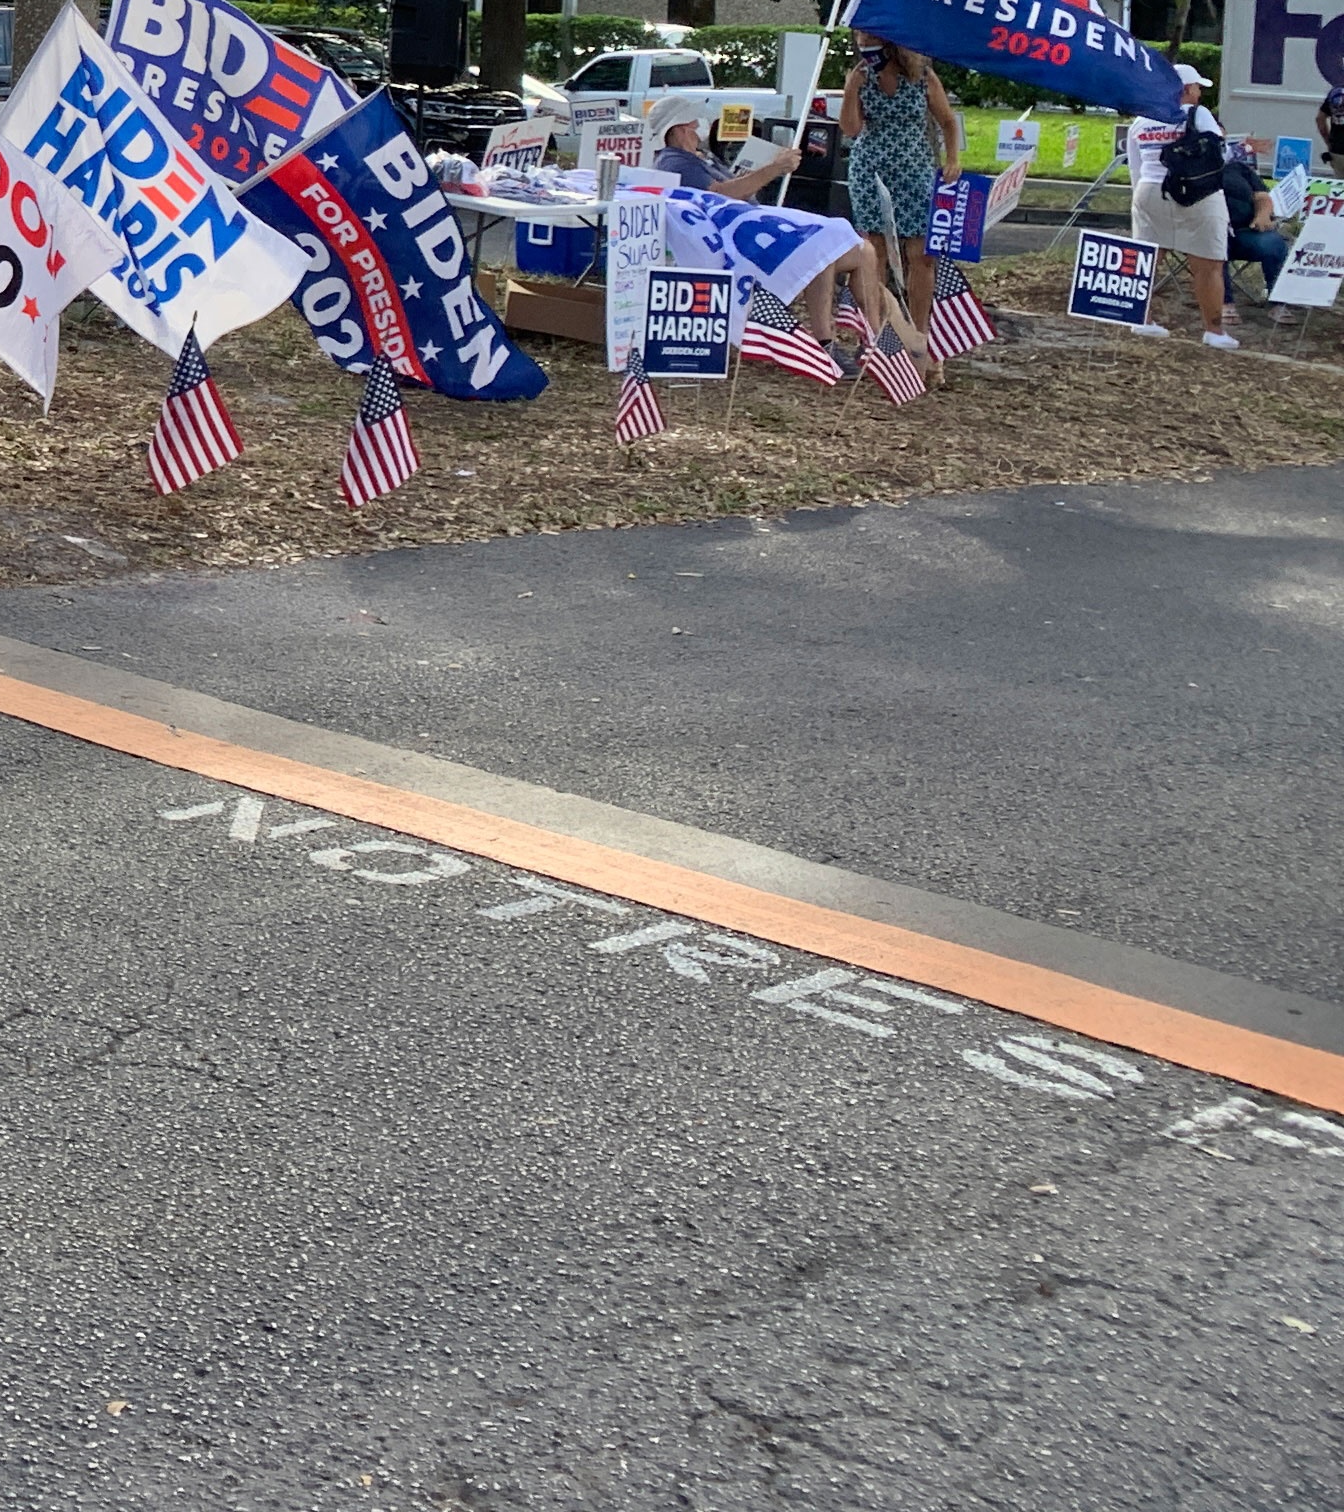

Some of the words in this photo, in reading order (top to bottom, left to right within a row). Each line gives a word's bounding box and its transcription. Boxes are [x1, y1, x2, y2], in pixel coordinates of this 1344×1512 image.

[987, 26, 1071, 66] 2020
[574, 107, 616, 119] BIDEN
[59, 45, 248, 262] BIDEN
[596, 136, 643, 152] HURTS
[300, 182, 359, 247] FOR
[619, 202, 660, 241] BIDEN
[950, 179, 970, 253] HARRIS
[363, 131, 511, 390] BIDEN
[616, 239, 661, 269] SWAG
[1081, 240, 1153, 278] BIDEN
[650, 280, 729, 314] BIDEN
[1078, 268, 1149, 301] HARRIS
[648, 315, 727, 344] HARRIS
